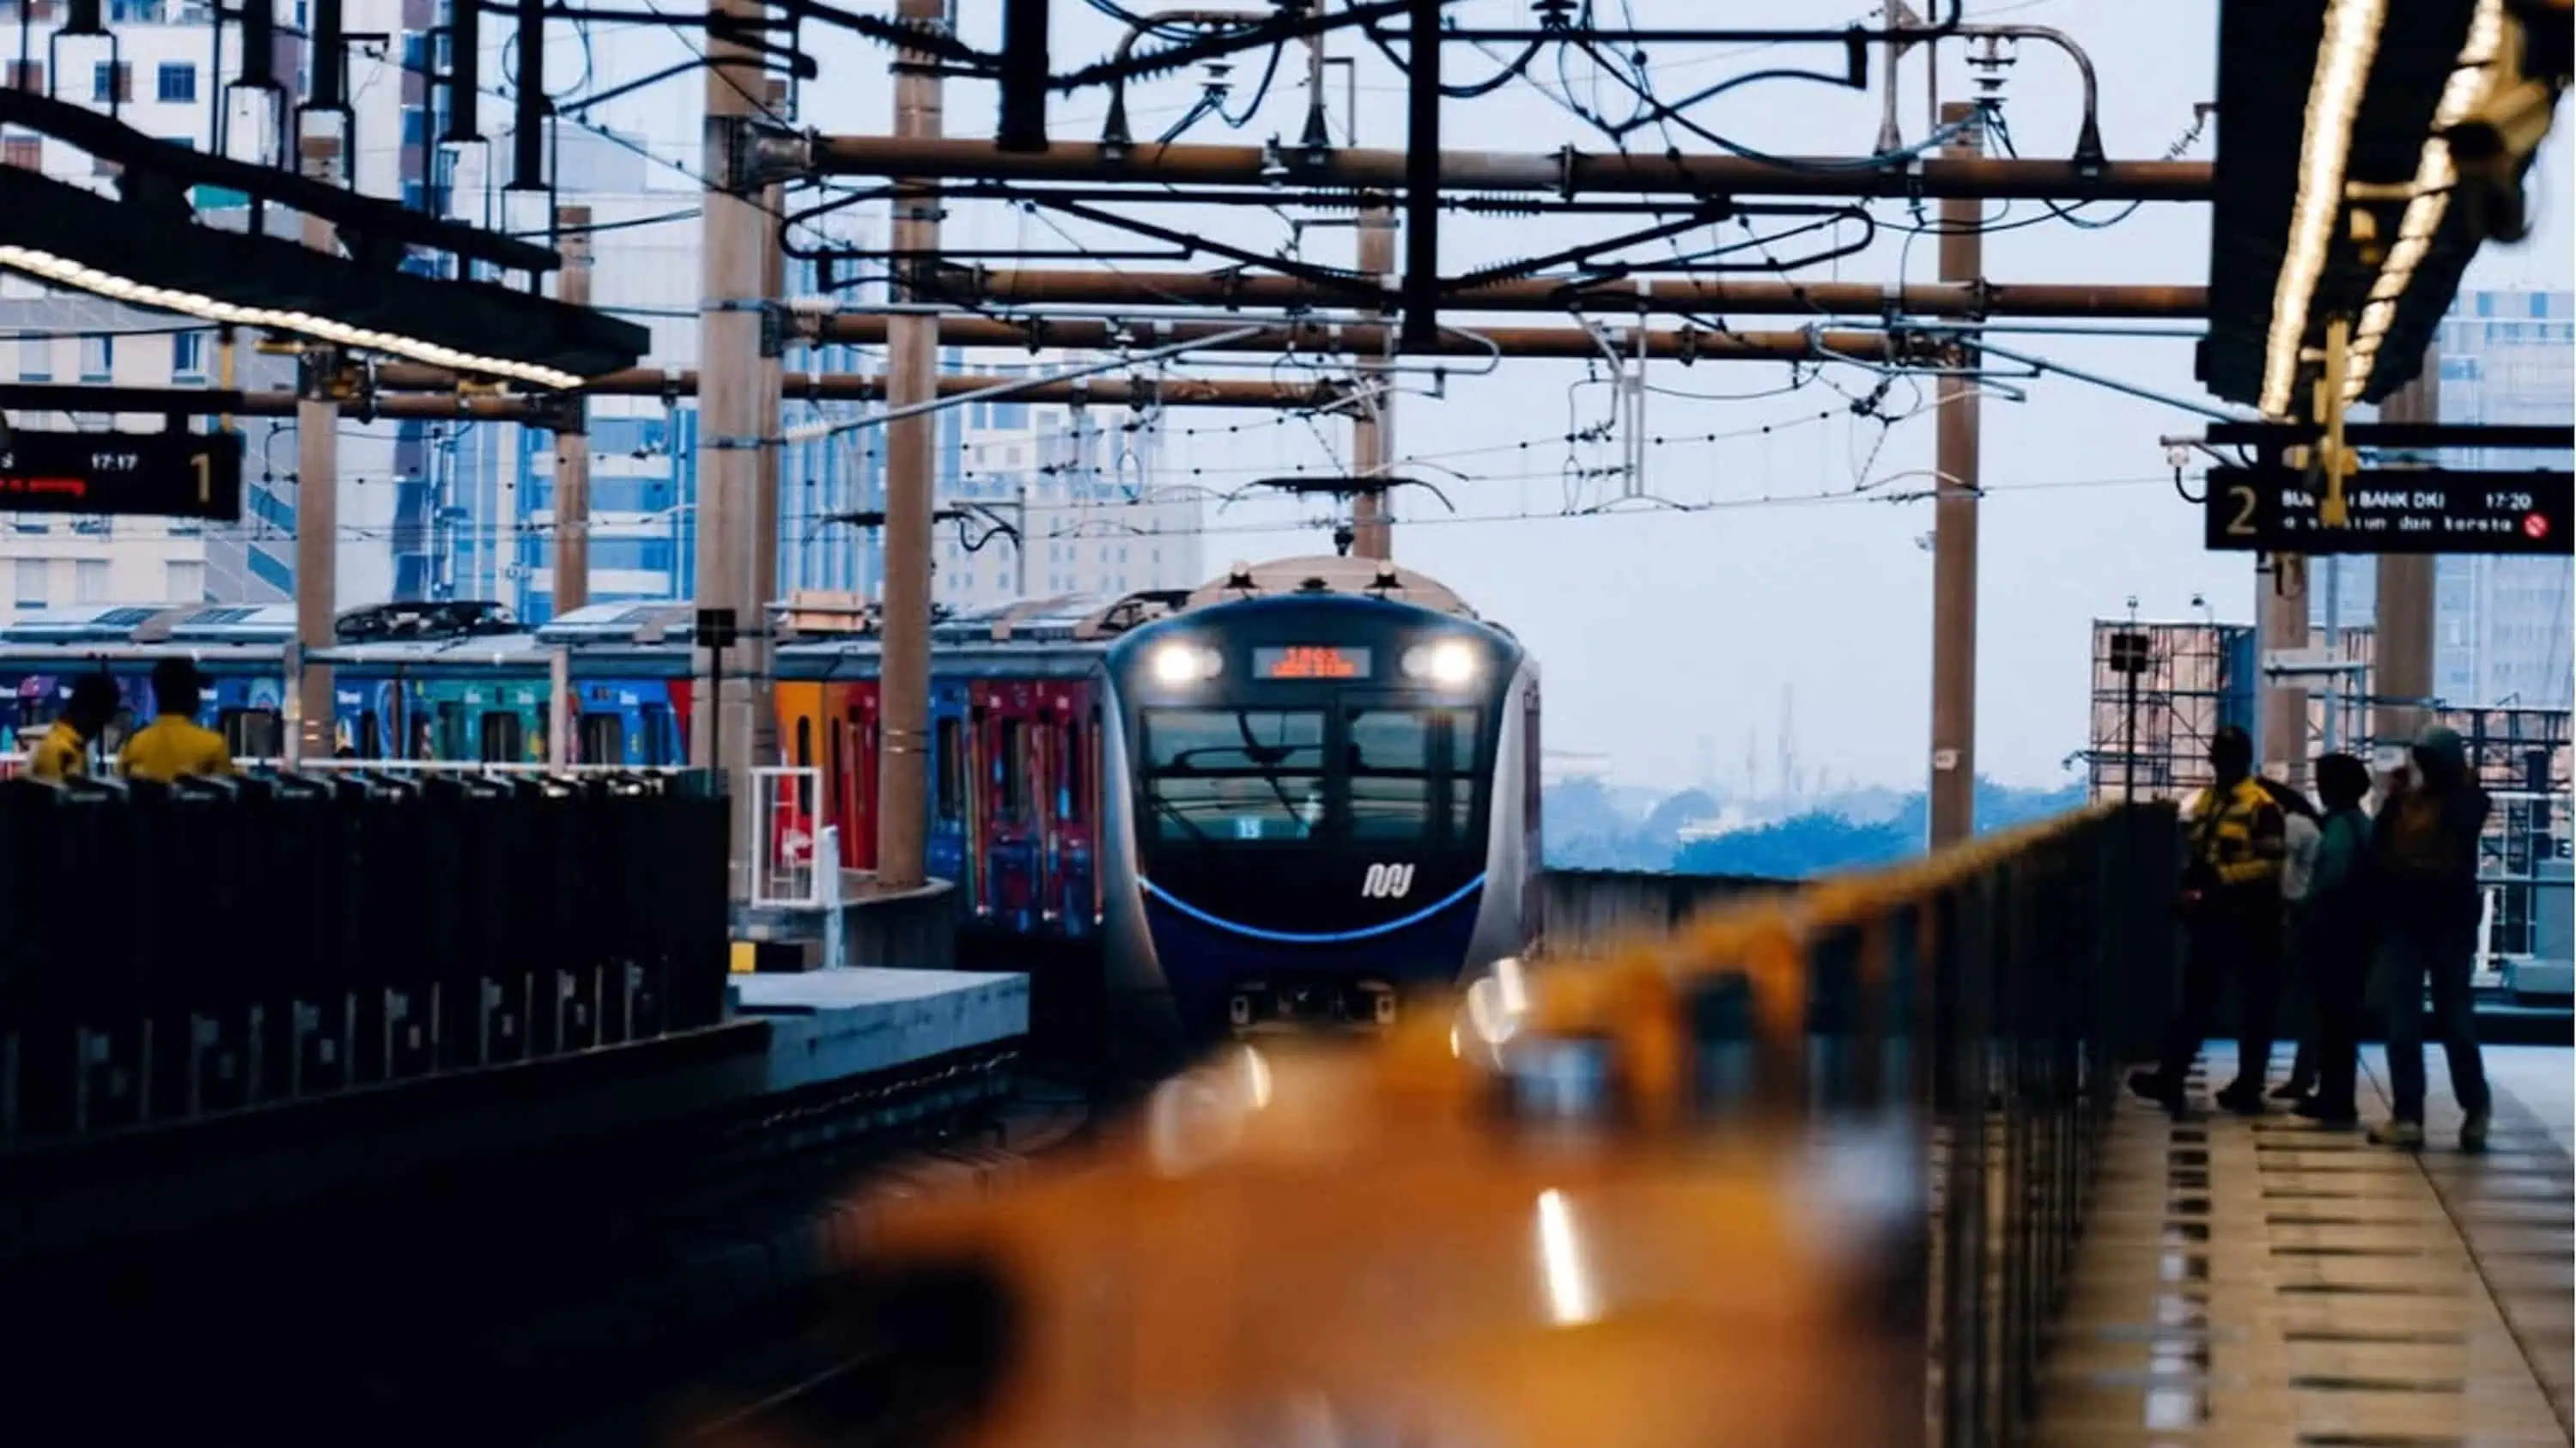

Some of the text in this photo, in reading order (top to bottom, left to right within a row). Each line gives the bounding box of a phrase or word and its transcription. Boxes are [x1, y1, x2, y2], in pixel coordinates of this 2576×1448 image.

[190, 453, 210, 502] 1
[2360, 490, 2408, 508] BANK
[2413, 491, 2445, 509] DKI
[2226, 486, 2257, 534] 2
